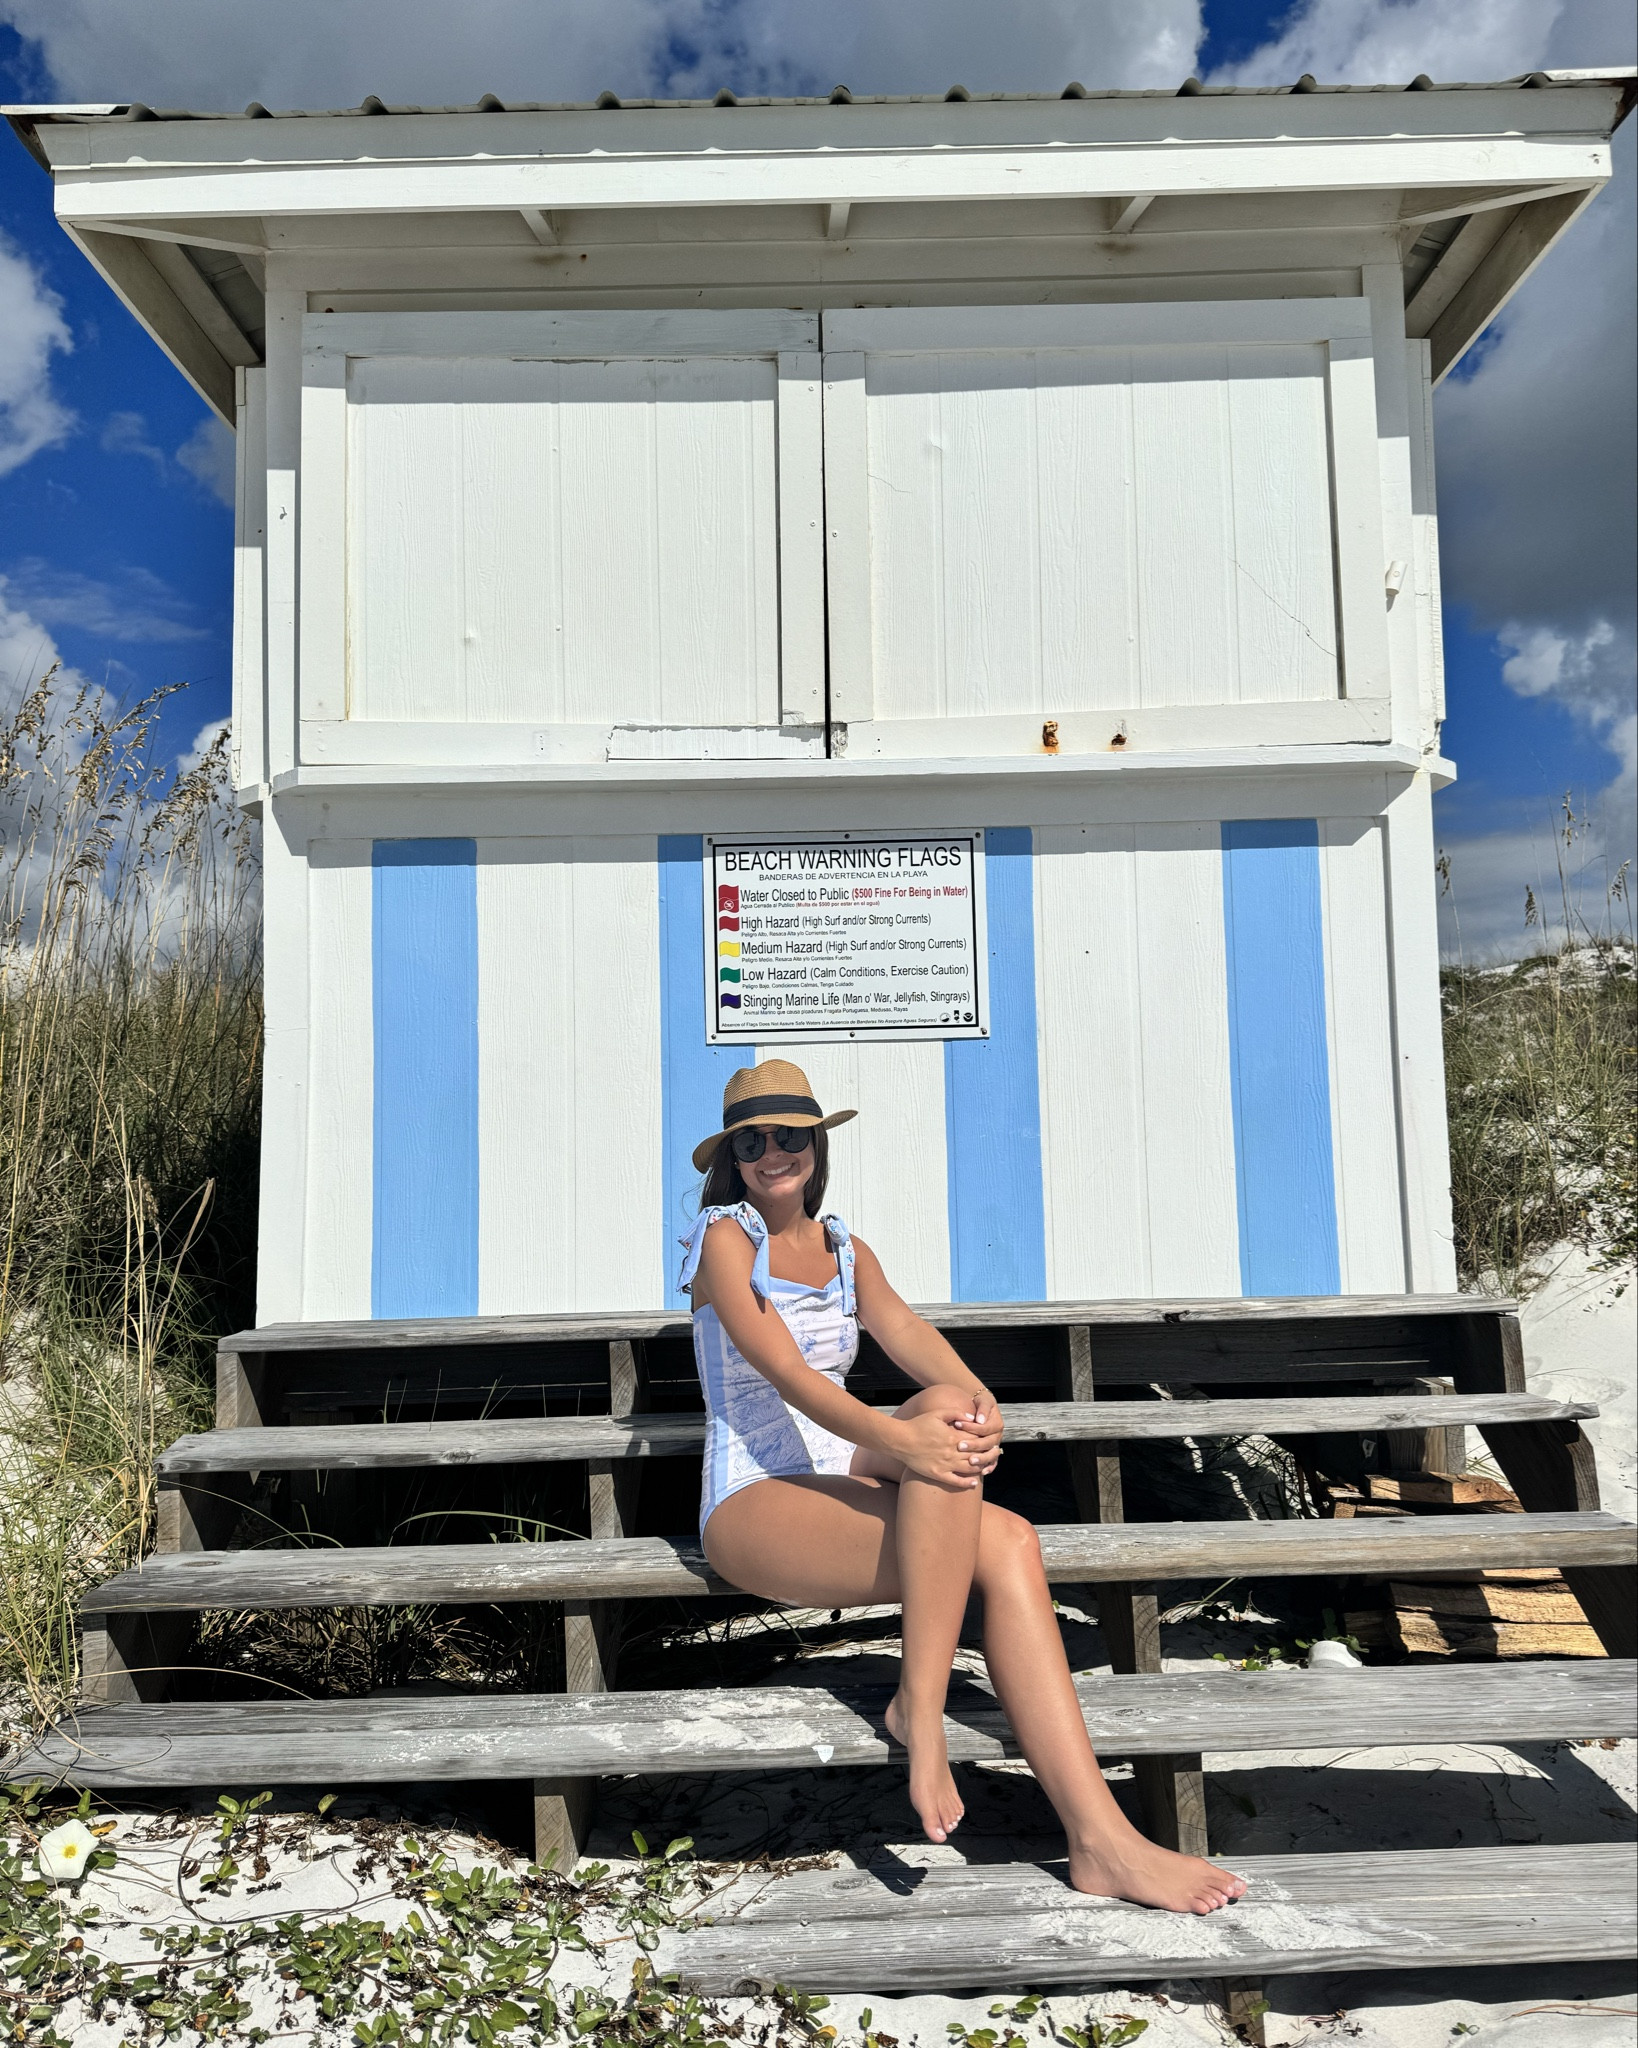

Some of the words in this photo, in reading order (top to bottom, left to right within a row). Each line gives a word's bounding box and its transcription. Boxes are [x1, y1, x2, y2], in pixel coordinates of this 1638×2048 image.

[725, 850, 791, 871] BEACH
[798, 848, 891, 870] WARNING
[898, 846, 961, 867] FLAGS
[760, 873, 803, 881] BANDERAS
[818, 872, 875, 880] ADVERTENCIA
[903, 870, 928, 878] PLAYA
[740, 889, 769, 902] Water
[772, 888, 805, 902] Closed
[808, 888, 817, 900] to
[820, 887, 849, 900] Public
[852, 887, 873, 900] ($500
[875, 887, 891, 898] Fine
[894, 887, 907, 897] For
[909, 886, 931, 899] Being
[934, 886, 940, 896] in
[943, 885, 968, 898] Water)
[741, 916, 763, 932] High
[765, 915, 799, 929] Hazard
[802, 915, 822, 929] (High
[824, 915, 841, 926] Surf
[842, 915, 867, 926] and/or
[869, 914, 893, 927] Strong
[896, 913, 931, 926] Currents)
[741, 941, 782, 954] Medium
[785, 940, 823, 954] Hazard
[825, 940, 848, 953] (High
[850, 940, 868, 951] Surf
[869, 939, 896, 950] and/or
[898, 938, 925, 951] Strong
[928, 938, 967, 951] Currents)
[741, 968, 764, 981] Low
[767, 966, 807, 980] Hazard
[810, 967, 836, 980] (Calm
[838, 966, 888, 978] Conditions,
[890, 965, 928, 976] Exercise
[931, 964, 969, 977] Caution)
[743, 994, 782, 1010] Stinging
[785, 993, 819, 1006] Marine
[822, 992, 840, 1006] Life
[842, 993, 863, 1006] (Man
[864, 993, 872, 1004] o'
[874, 992, 892, 1004] War,
[894, 991, 928, 1005] Jellyfish,
[930, 990, 970, 1004] Stingrays)
